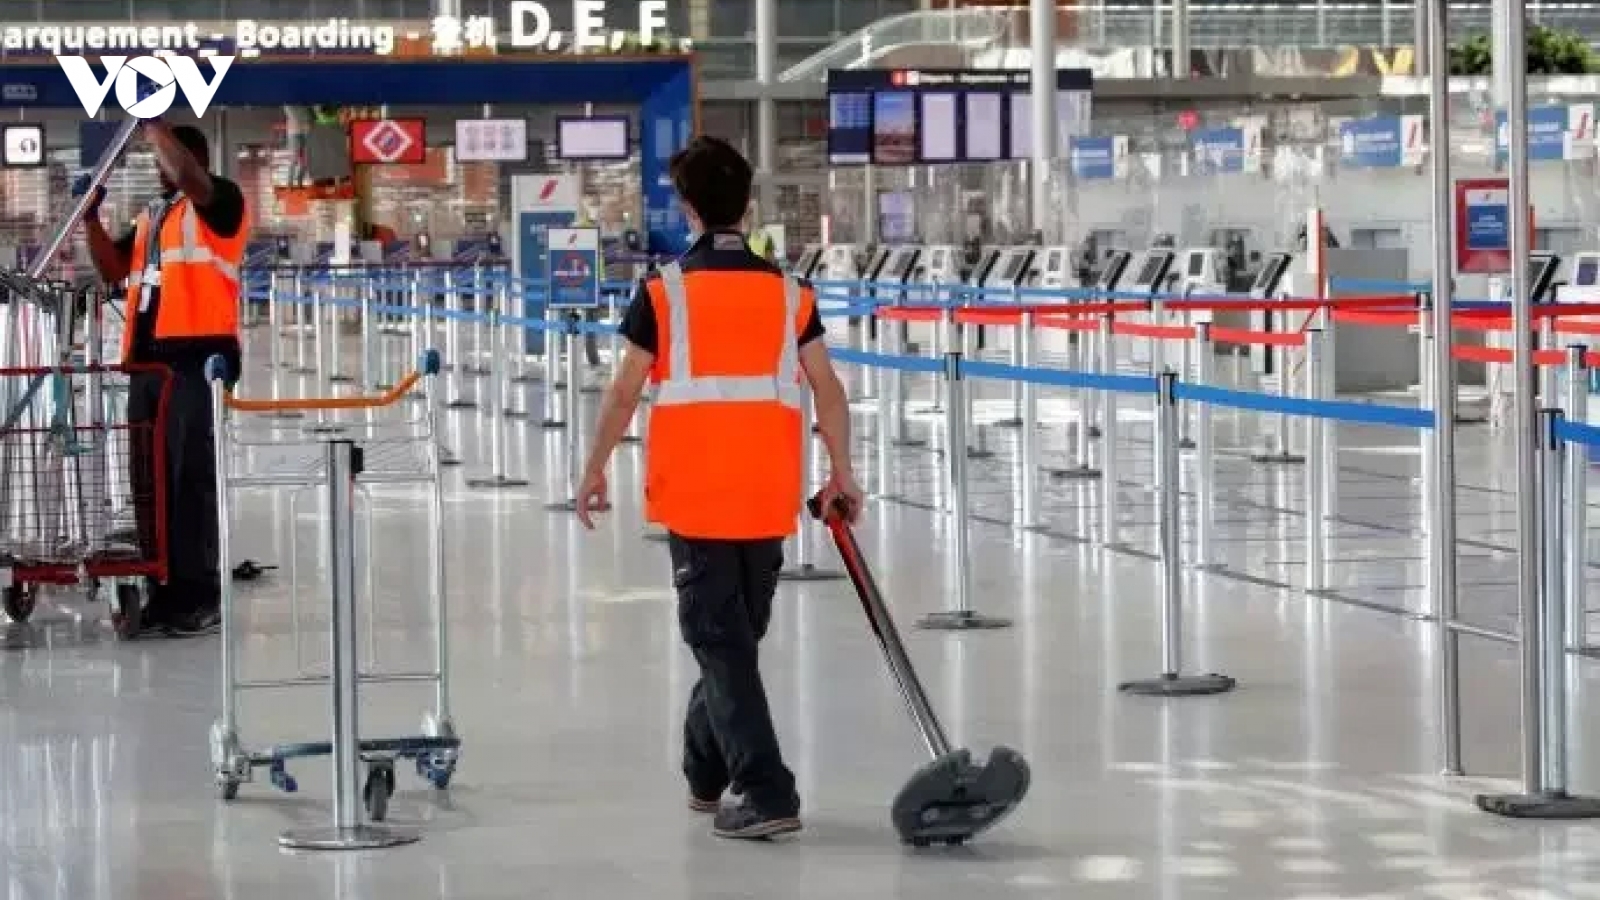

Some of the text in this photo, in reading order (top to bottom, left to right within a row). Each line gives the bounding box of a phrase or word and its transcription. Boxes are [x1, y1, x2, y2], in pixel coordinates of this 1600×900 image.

[0, 22, 199, 54] arquement
[237, 19, 393, 53] Boarding
[511, 0, 561, 50] D,
[576, 0, 624, 50] E,
